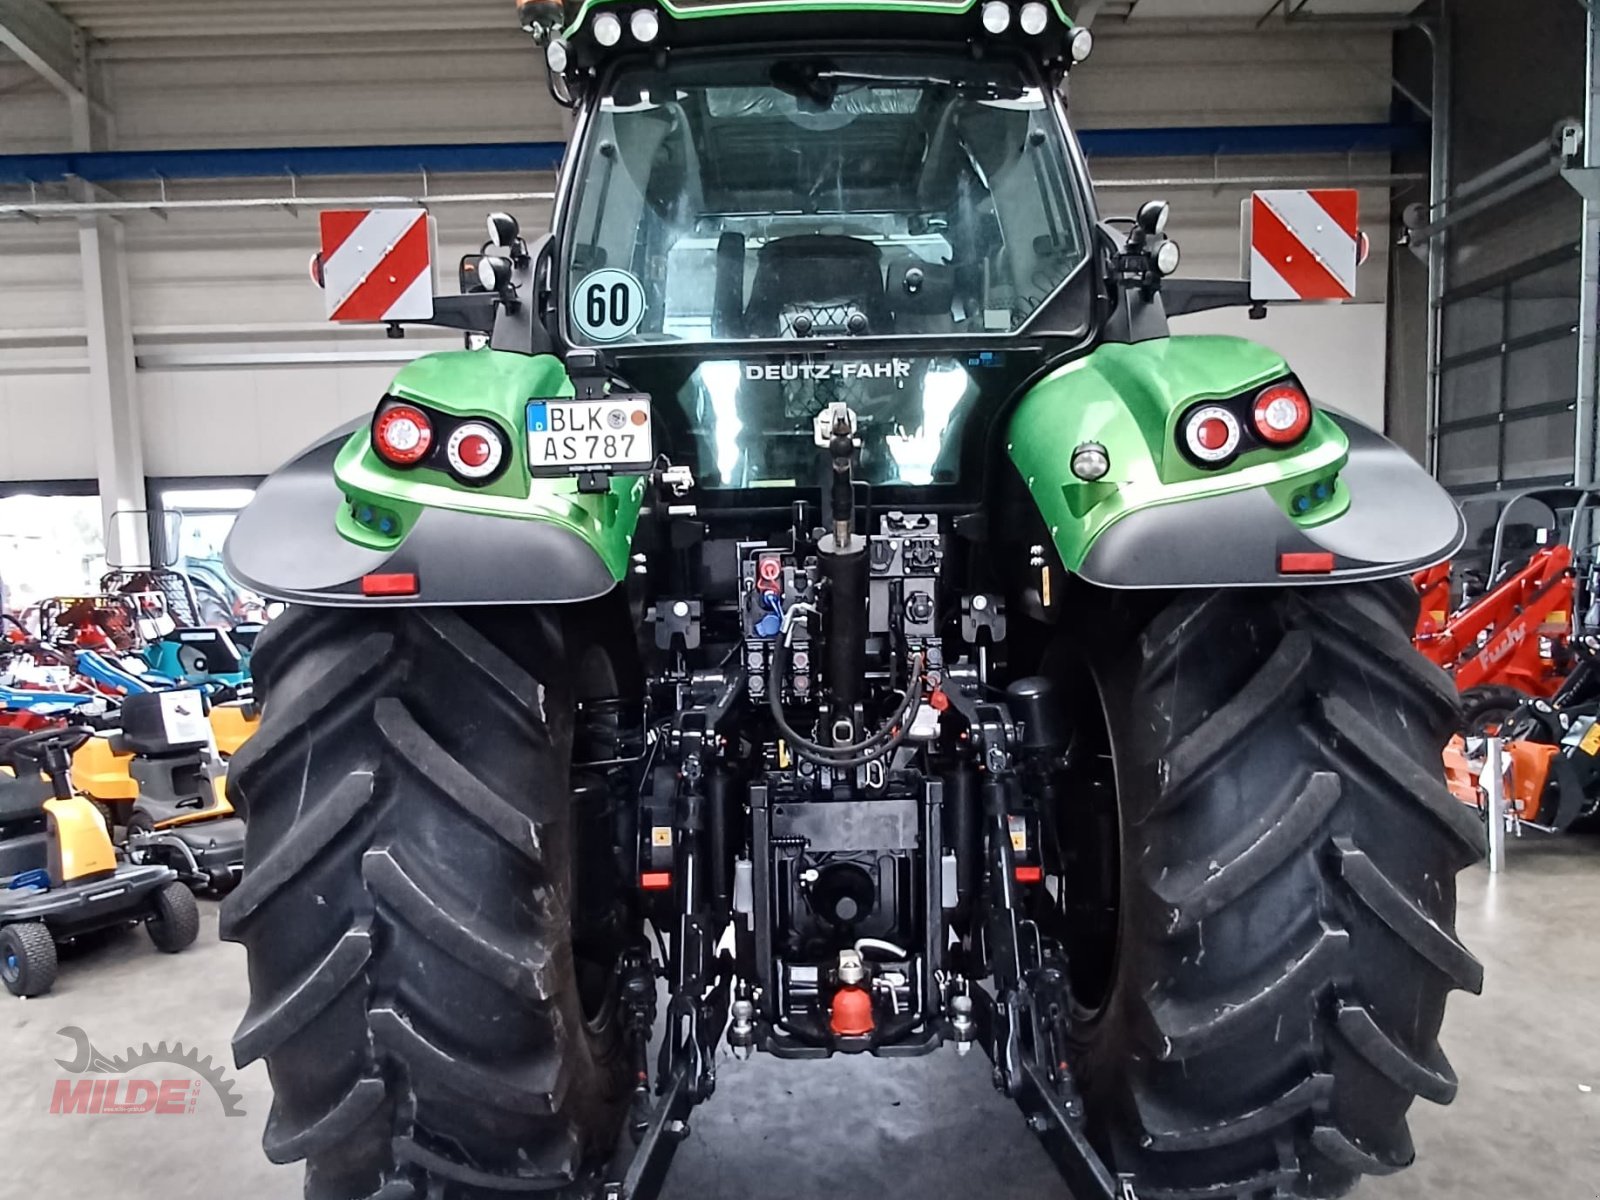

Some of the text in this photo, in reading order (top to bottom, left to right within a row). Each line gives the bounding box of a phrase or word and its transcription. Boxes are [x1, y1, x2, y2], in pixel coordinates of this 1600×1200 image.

[587, 283, 629, 327] 60
[746, 361, 910, 380] DEUTZ-FAHR
[550, 407, 603, 432] BLK
